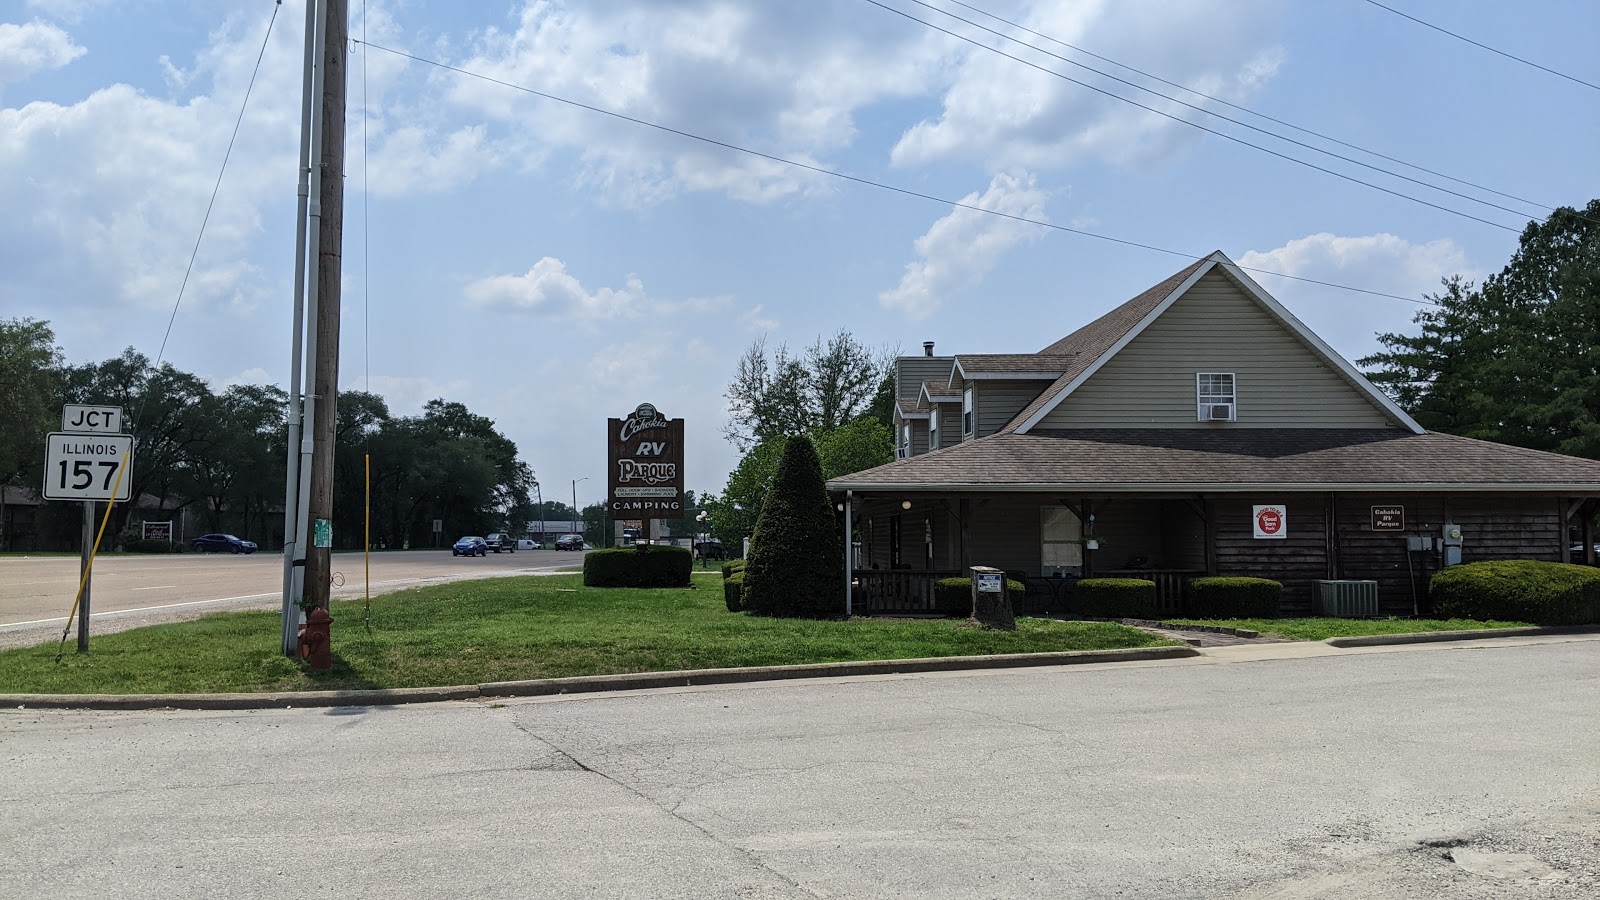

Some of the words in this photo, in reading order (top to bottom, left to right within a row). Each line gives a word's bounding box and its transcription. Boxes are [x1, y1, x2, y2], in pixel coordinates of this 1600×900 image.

[71, 410, 114, 428] JCT
[620, 416, 668, 442] Cahokia
[63, 443, 117, 456] ILLINOIS
[635, 441, 666, 456] RV
[59, 460, 119, 491] 157
[612, 502, 679, 510] CAMPING
